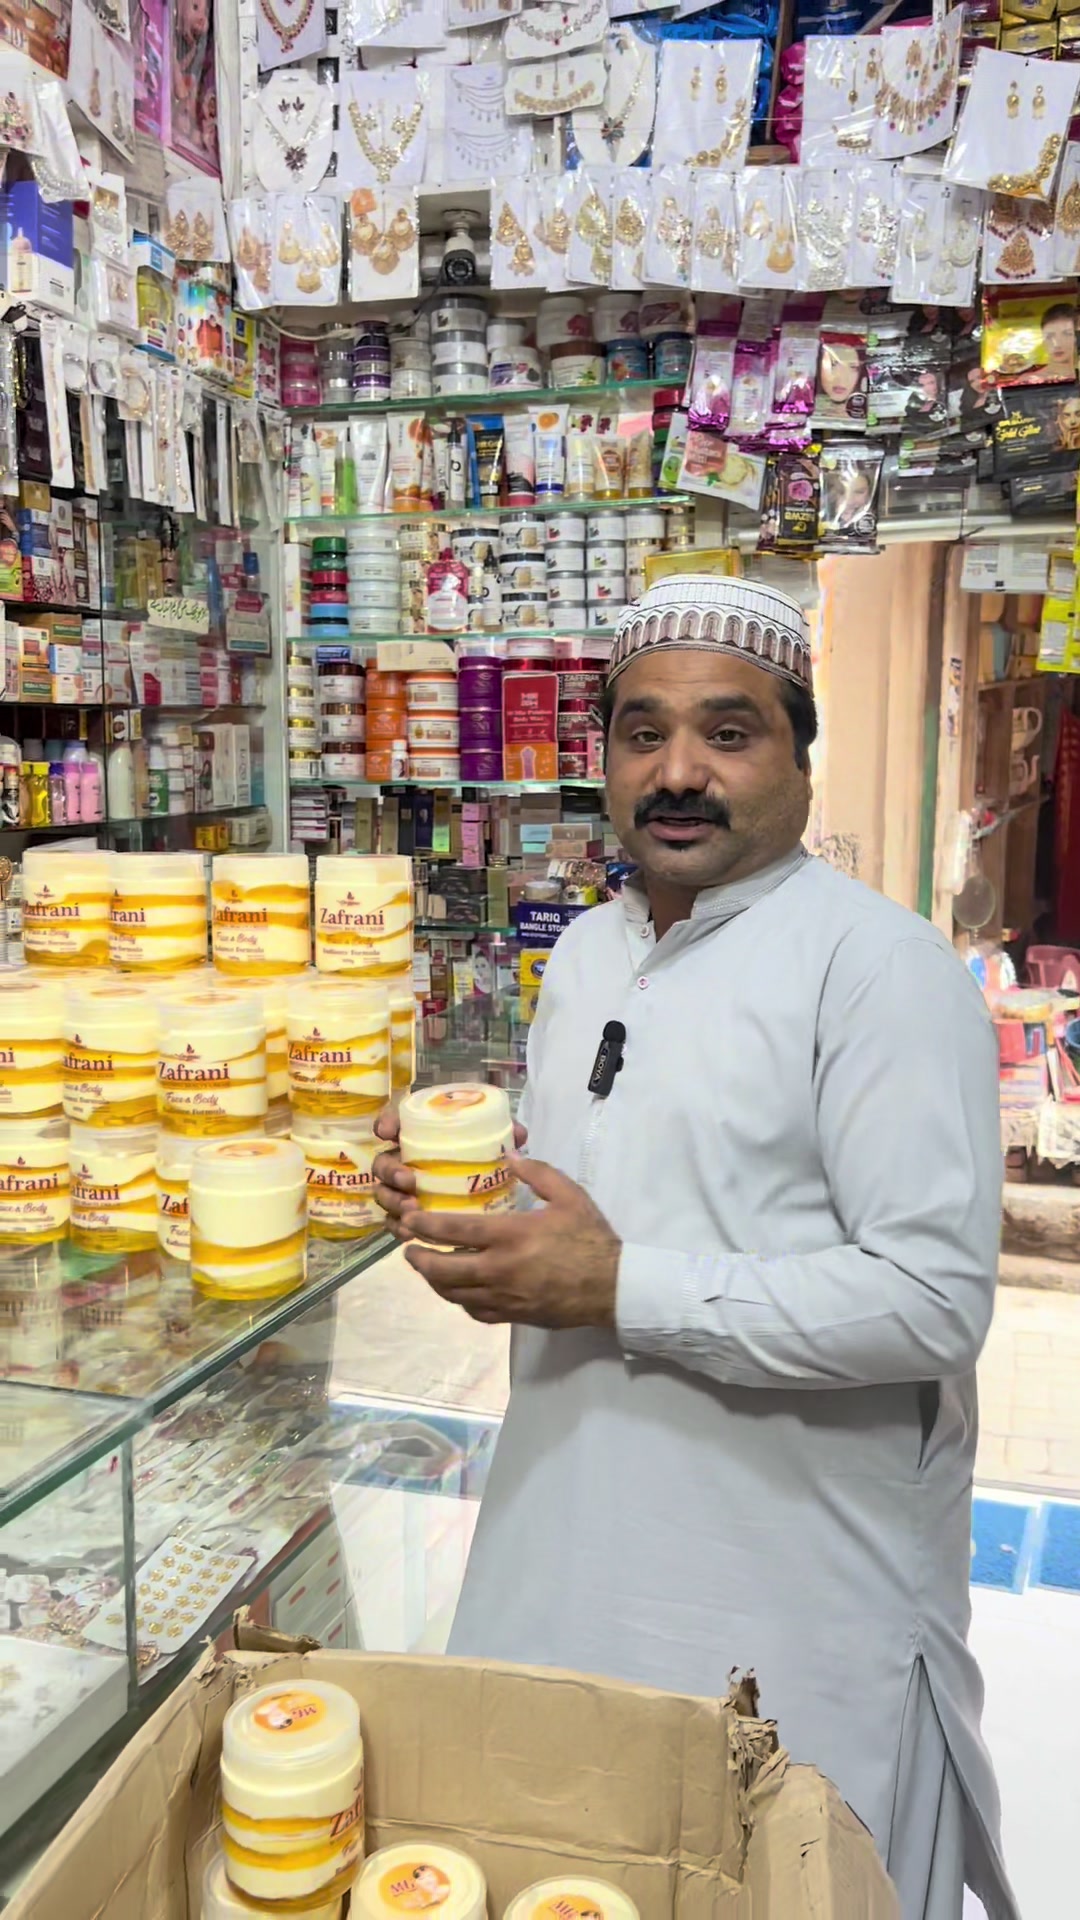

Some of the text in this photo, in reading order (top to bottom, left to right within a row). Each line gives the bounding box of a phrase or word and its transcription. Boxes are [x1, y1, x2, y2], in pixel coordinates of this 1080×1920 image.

[320, 908, 384, 926] Zafrani
[530, 911, 561, 924] TARIQ
[520, 922, 547, 932] BANGLE
[288, 1042, 353, 1063] Zafrani
[158, 1061, 230, 1081] Zafrani
[593, 1054, 608, 1082] BOYA
